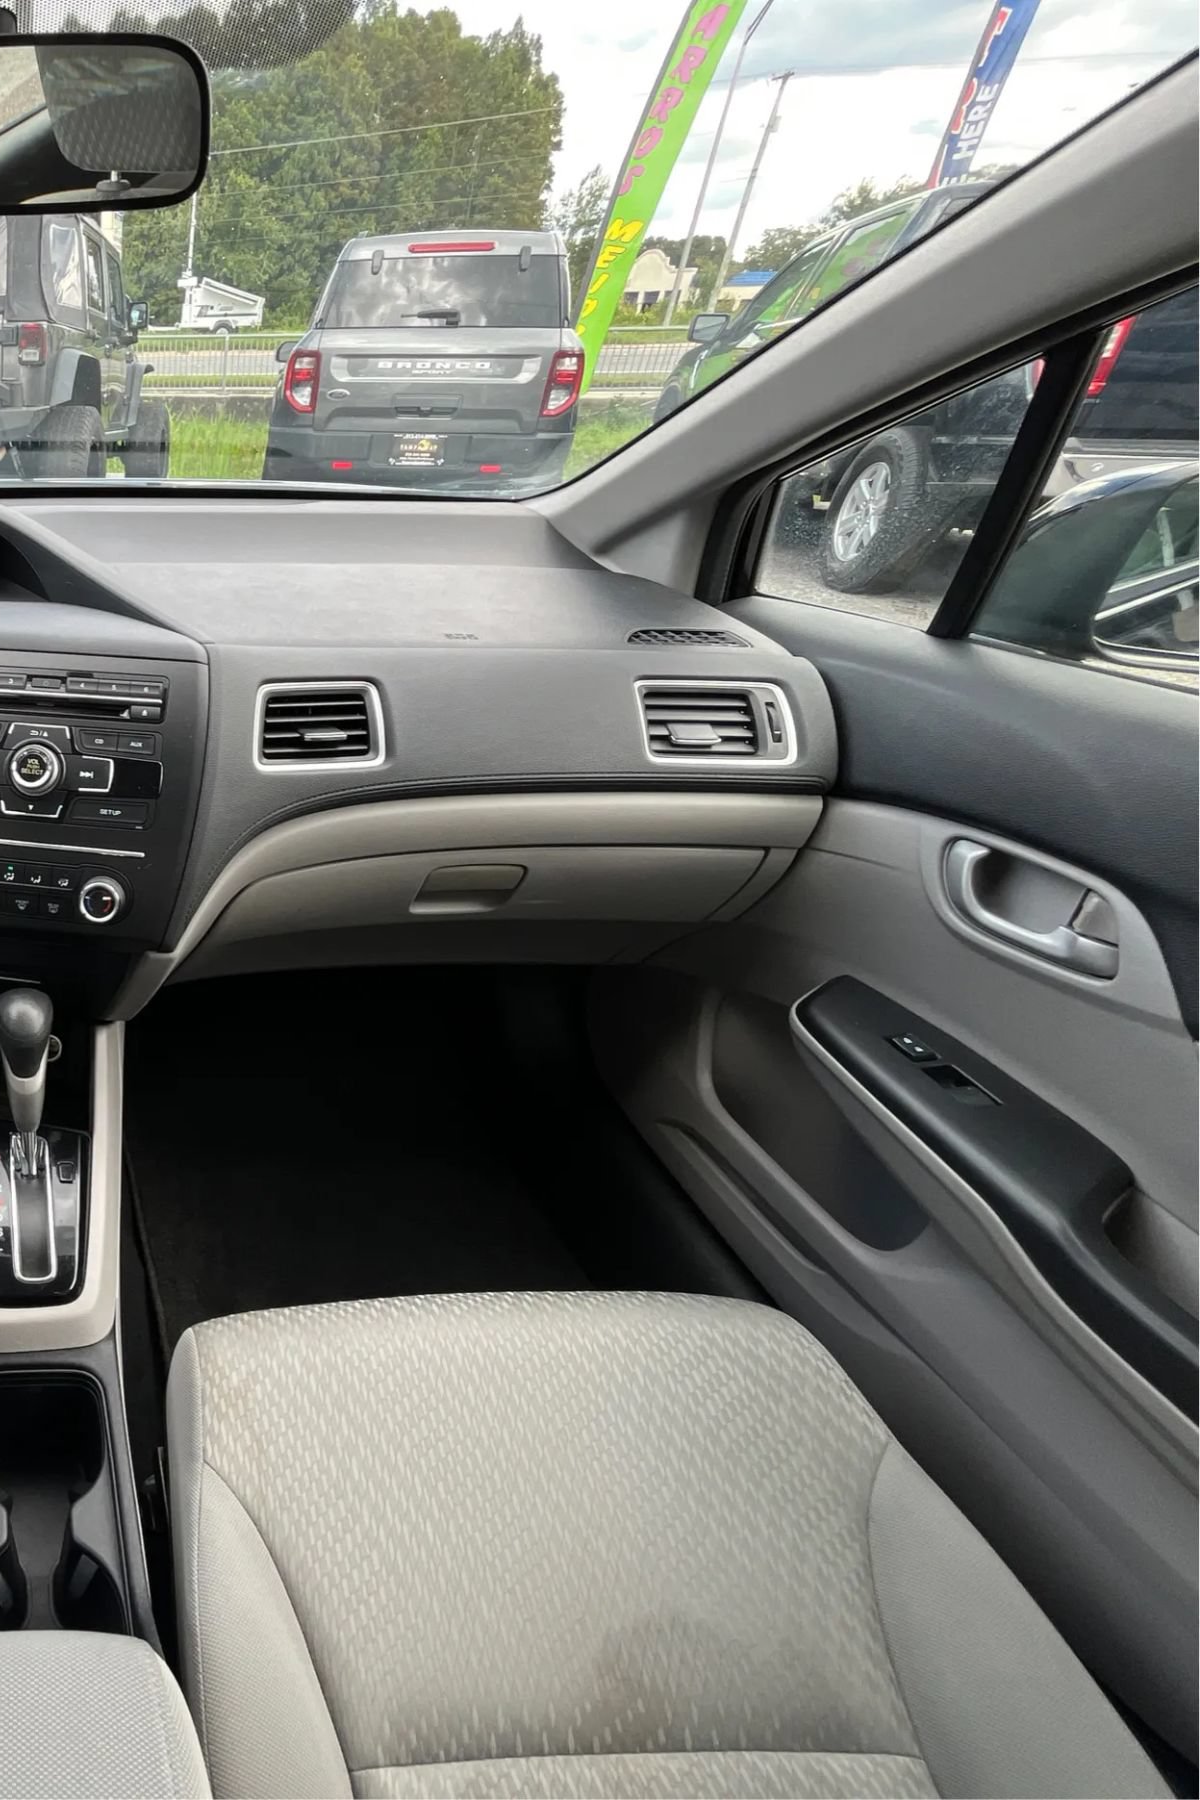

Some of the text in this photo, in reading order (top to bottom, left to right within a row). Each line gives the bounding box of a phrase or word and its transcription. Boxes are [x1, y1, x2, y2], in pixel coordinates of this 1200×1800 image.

[952, 83, 999, 160] HERE
[377, 360, 492, 370] BRONCO
[20, 767, 44, 775] SELECT
[99, 808, 122, 816] SETUP
